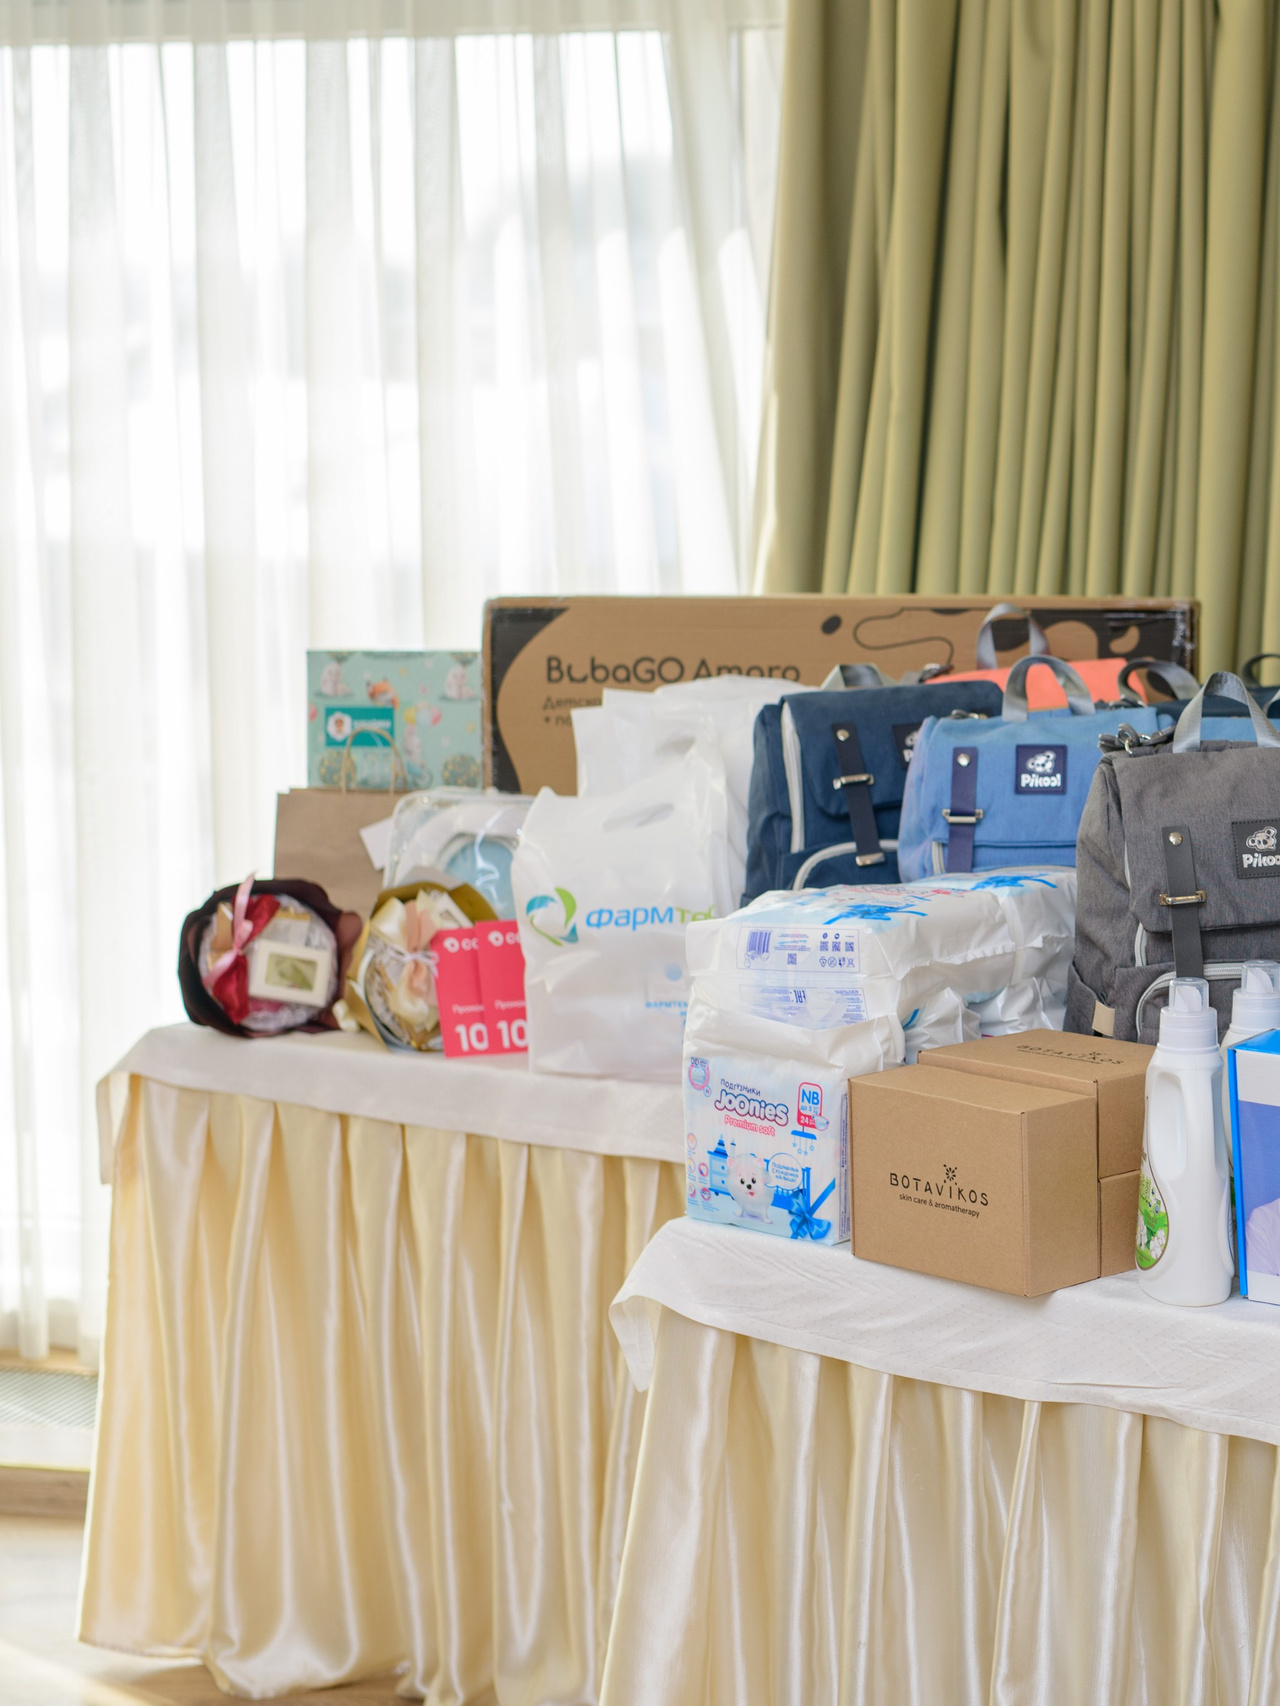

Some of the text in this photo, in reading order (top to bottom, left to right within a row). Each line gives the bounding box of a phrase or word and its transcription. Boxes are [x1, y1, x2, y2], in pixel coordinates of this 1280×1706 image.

[1020, 773, 1062, 788] Pikool
[801, 1089, 820, 1106] NB
[724, 1114, 776, 1137] Premium soft
[800, 1116, 809, 1125] 24
[890, 1172, 989, 1206] BOTAVIKOS
[899, 1193, 912, 1202] skin
[913, 1196, 927, 1205] care
[935, 1201, 980, 1218] aromatherapy
